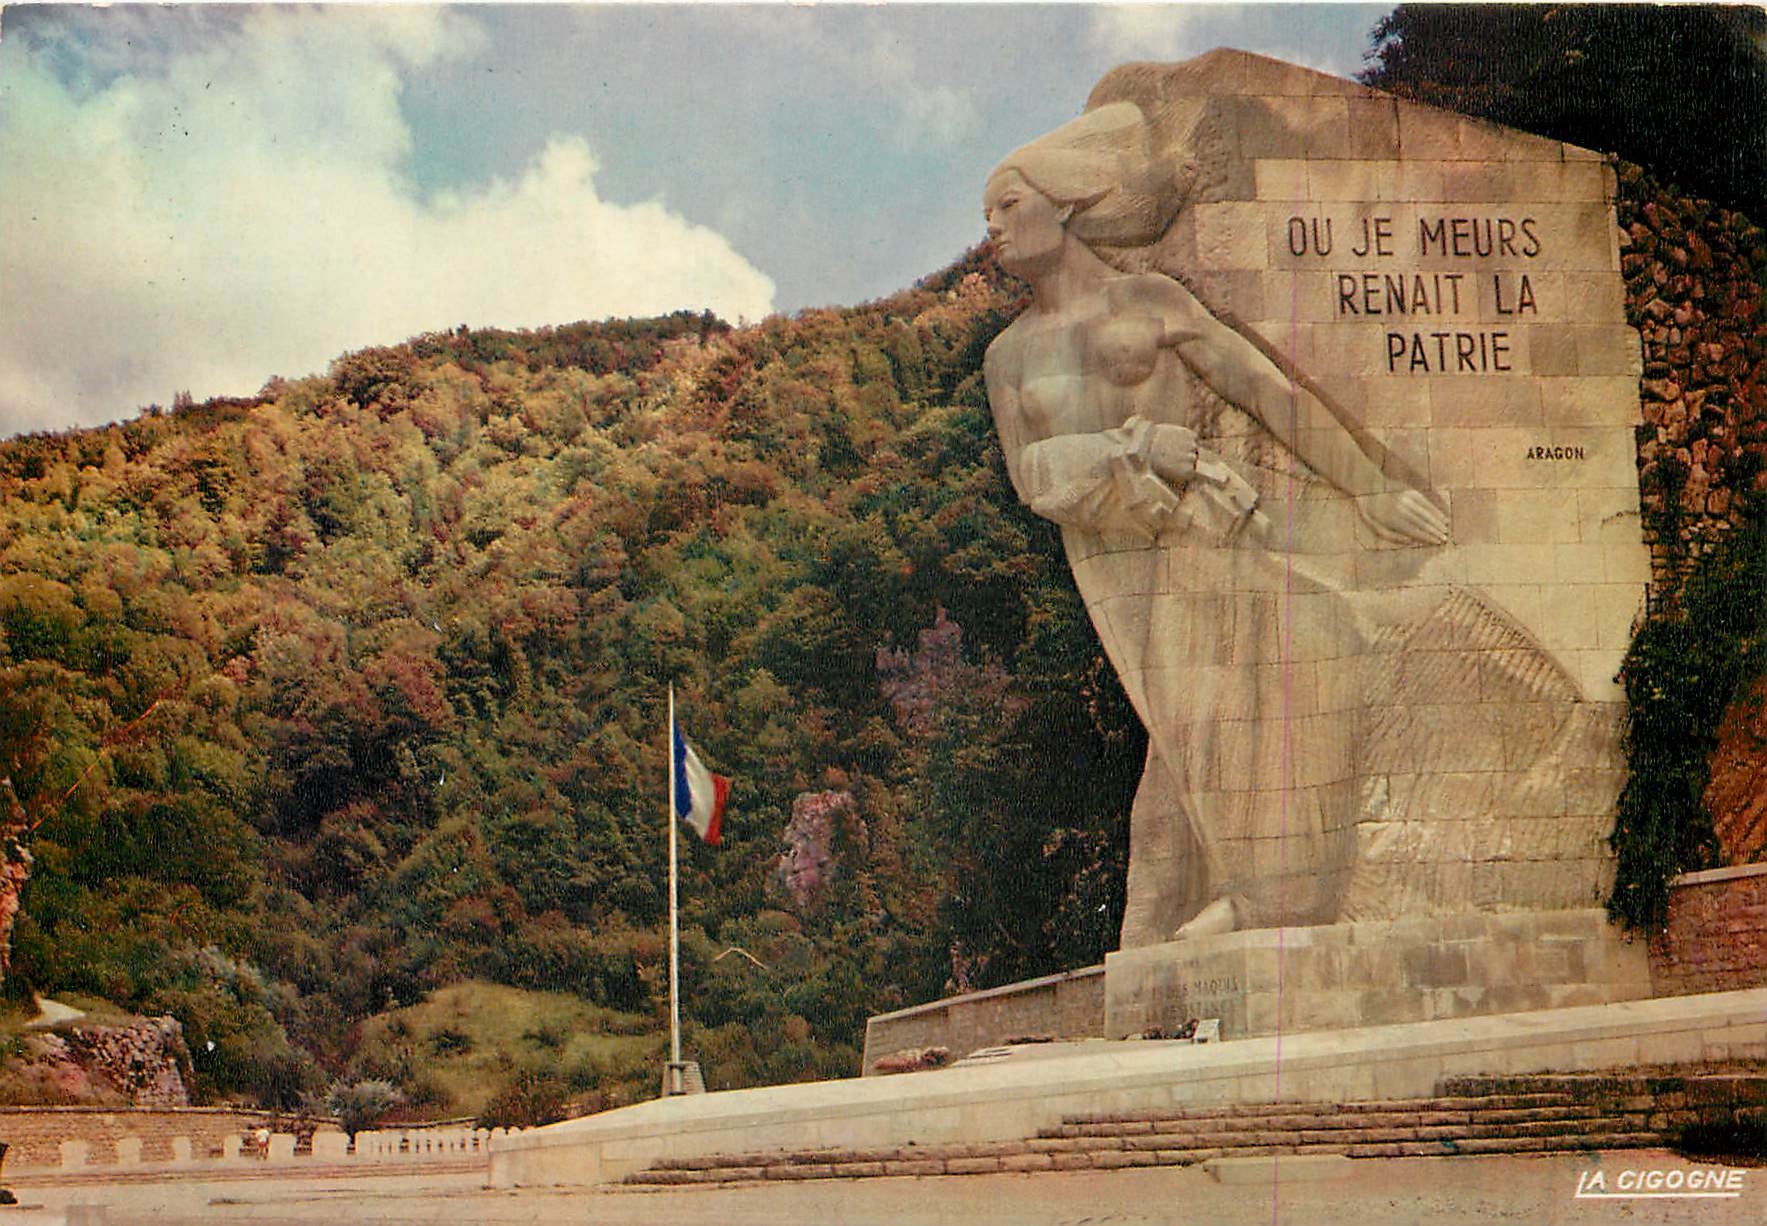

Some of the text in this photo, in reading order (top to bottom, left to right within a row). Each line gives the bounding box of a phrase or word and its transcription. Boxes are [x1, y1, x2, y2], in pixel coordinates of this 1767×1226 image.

[1288, 217, 1541, 257] OU JE MEURS
[1338, 275, 1538, 315] RENAIT LA
[1387, 333, 1511, 373] PATRIE
[1526, 447, 1585, 460] ARAGON
